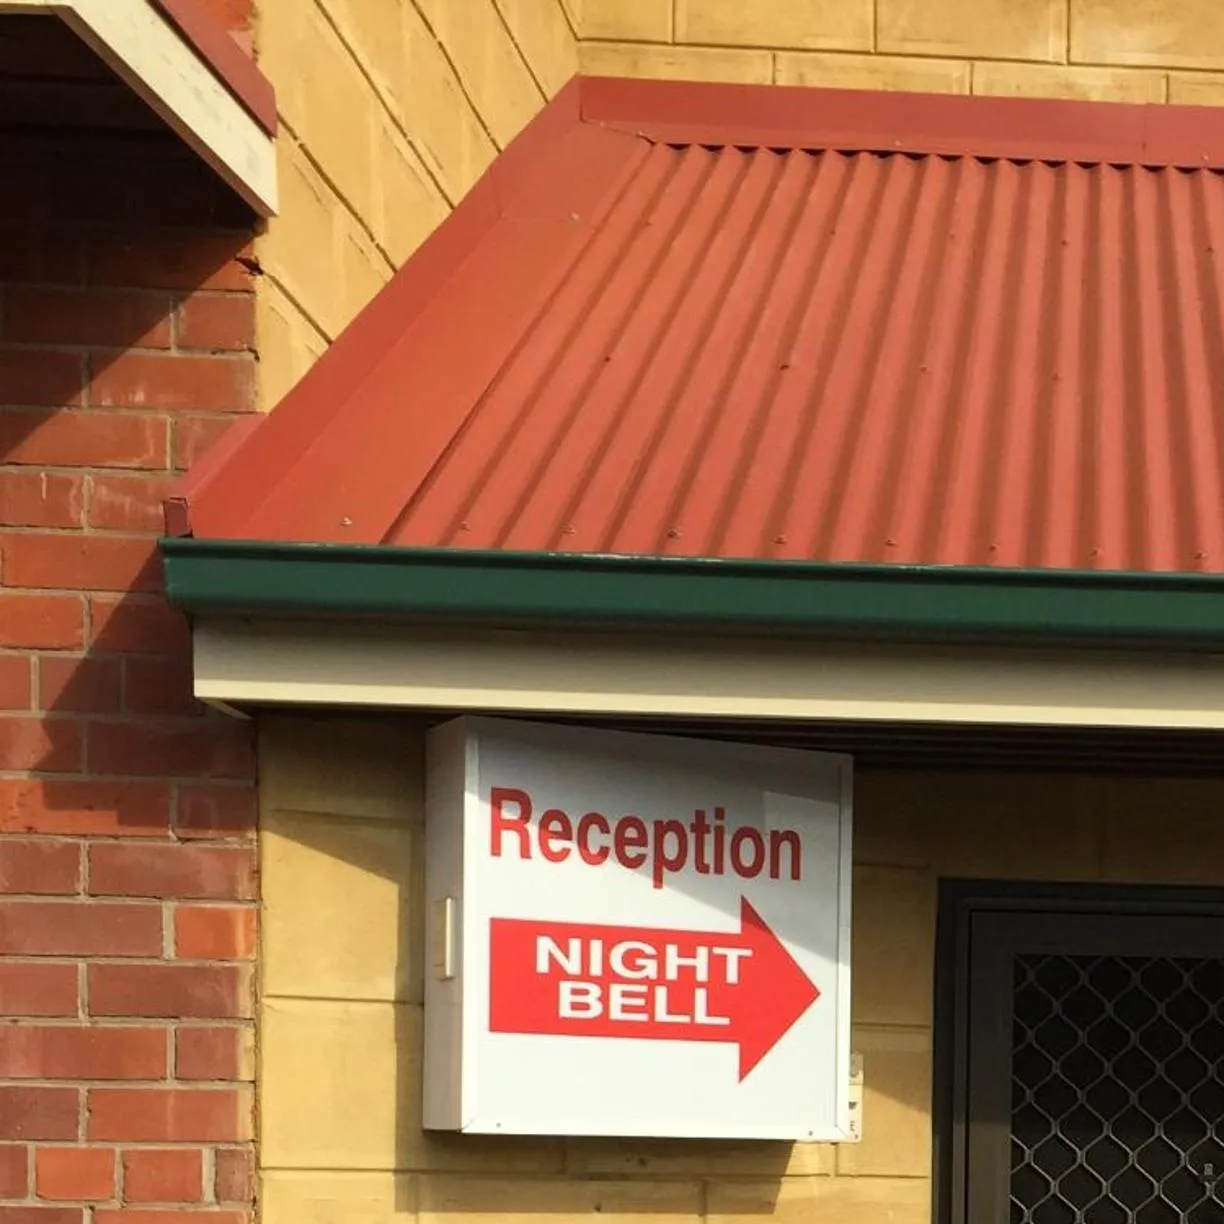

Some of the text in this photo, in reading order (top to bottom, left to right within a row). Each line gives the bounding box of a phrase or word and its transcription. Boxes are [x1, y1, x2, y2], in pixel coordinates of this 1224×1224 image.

[489, 786, 802, 889] Reception
[535, 935, 753, 984] NIGHT
[558, 980, 731, 1025] BELL
